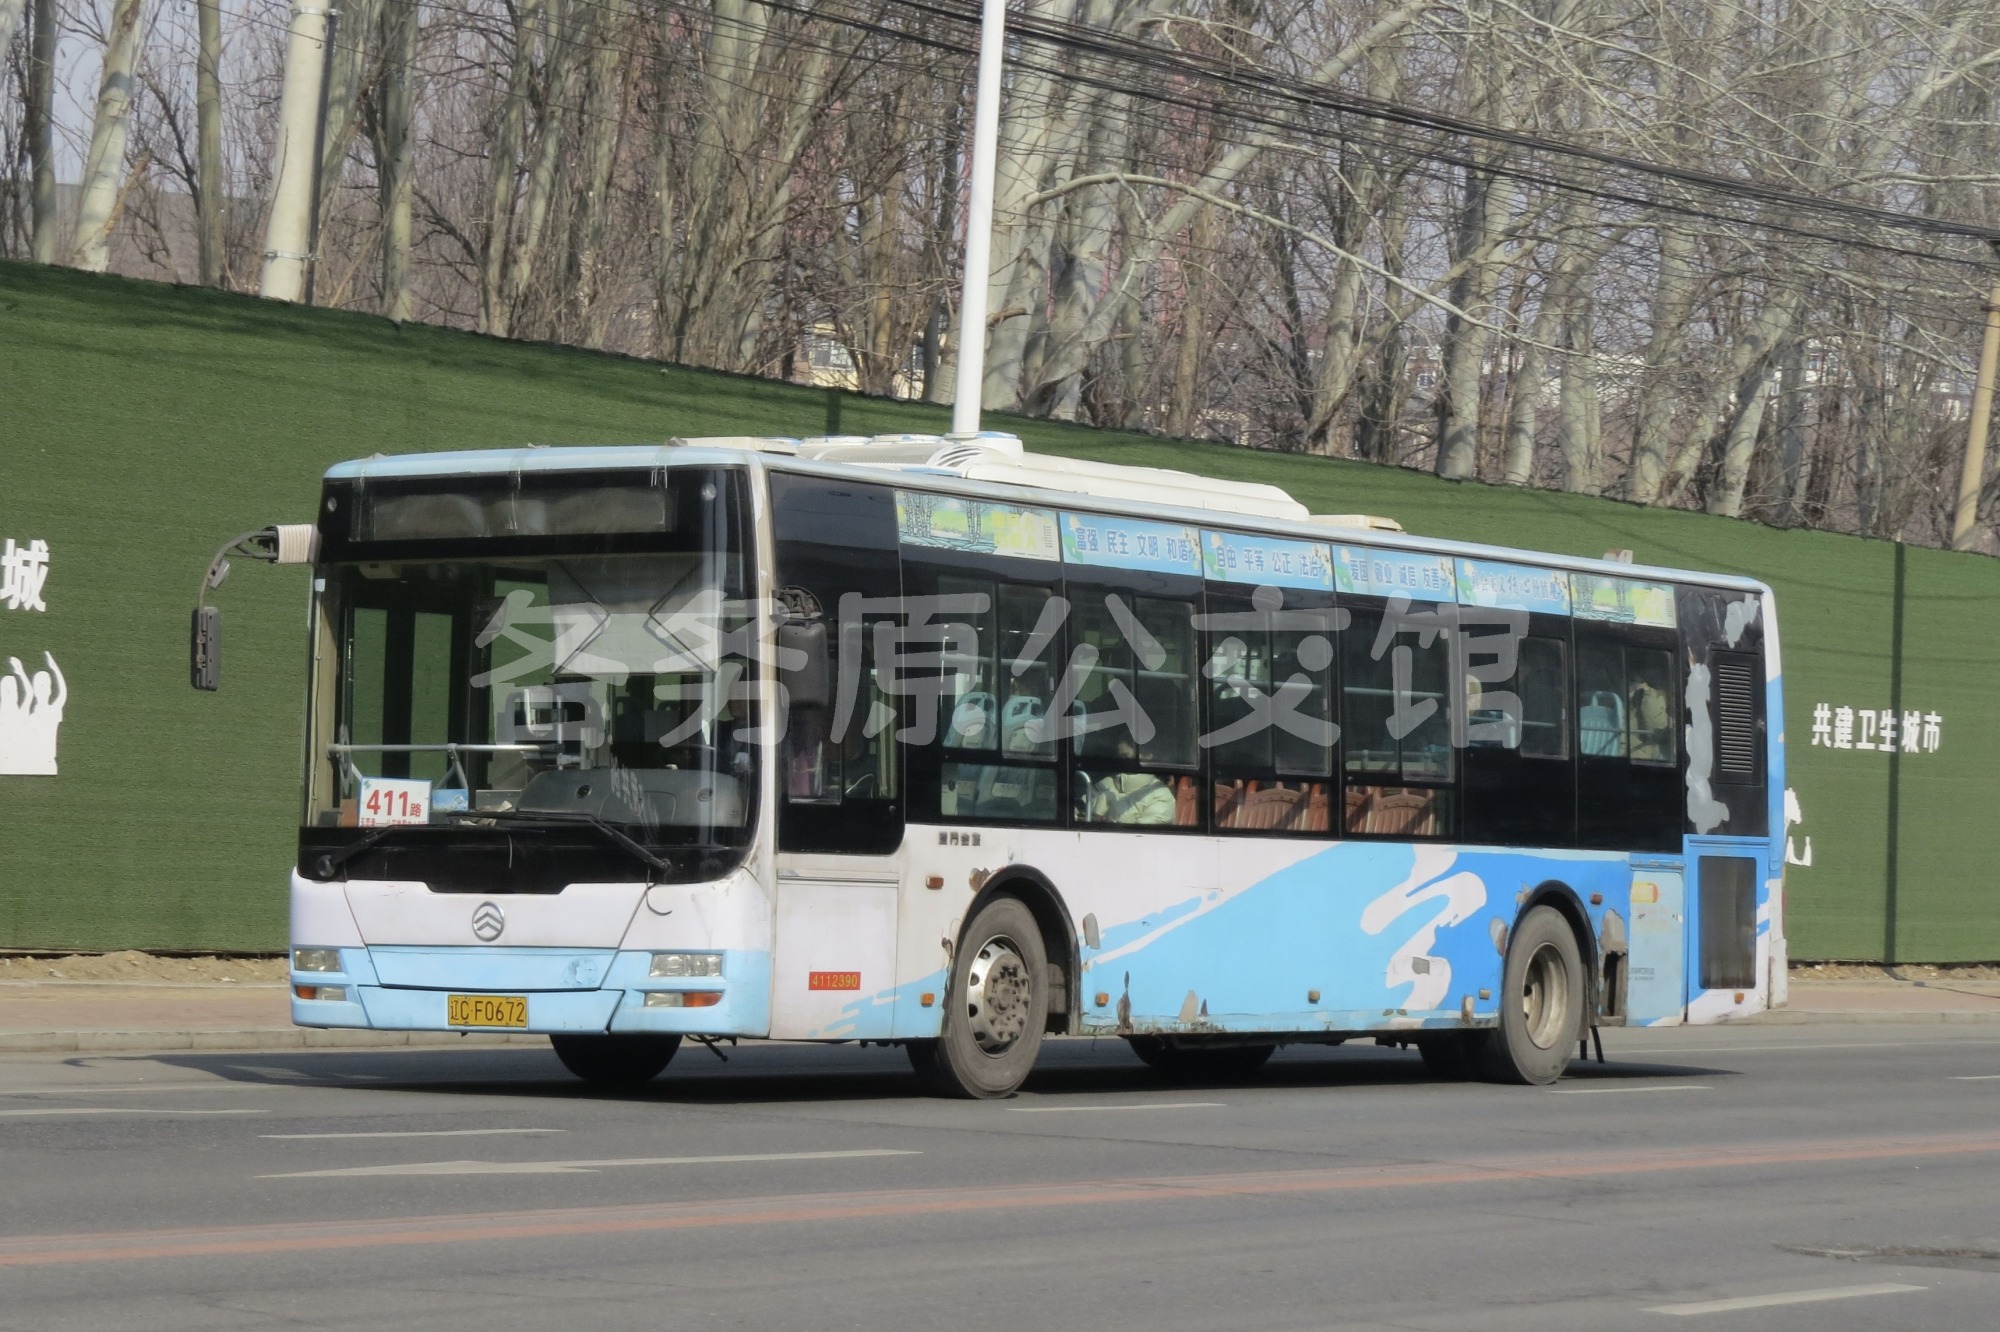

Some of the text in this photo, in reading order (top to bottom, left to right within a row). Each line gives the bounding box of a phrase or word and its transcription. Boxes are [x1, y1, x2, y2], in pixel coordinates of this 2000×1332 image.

[1075, 527, 1099, 552] 富强
[1106, 531, 1129, 555] 民主
[1137, 534, 1159, 558] 文明
[1167, 537, 1189, 562] 和谐
[0, 538, 50, 612] 城
[1216, 546, 1319, 577] 自由 平等 公正 法治
[1350, 559, 1369, 582] 爱国
[1400, 564, 1417, 586] 诚信
[1422, 567, 1440, 589] 友善
[1811, 703, 1942, 753] 共建卫生城市
[366, 789, 422, 817] 411路
[812, 974, 858, 988] 4112390
